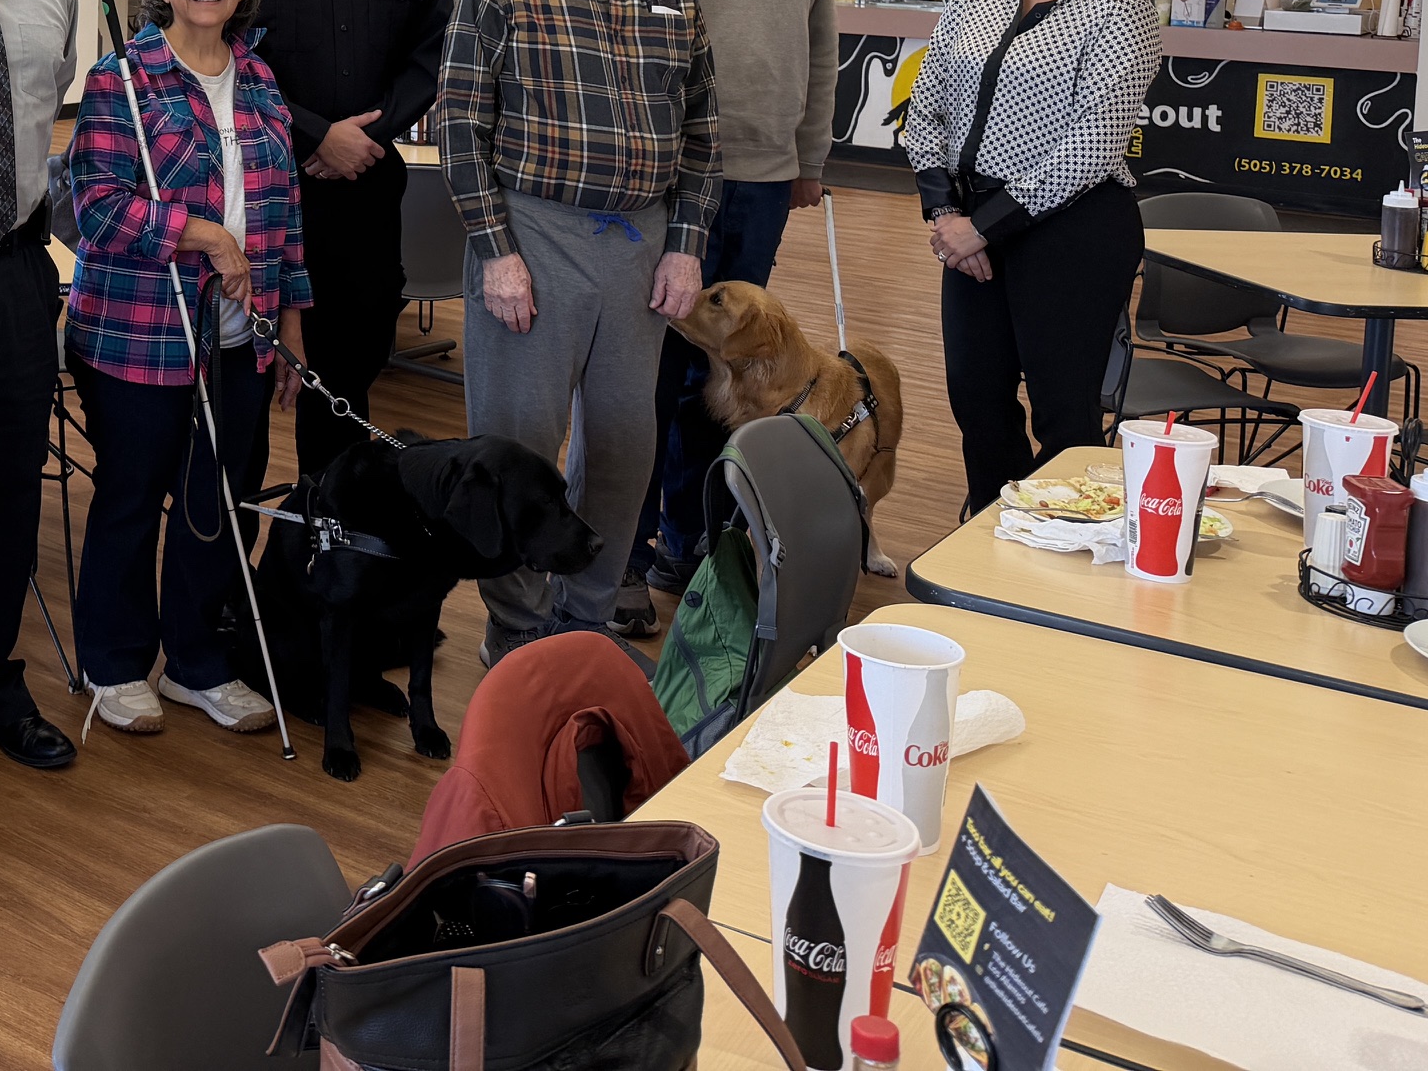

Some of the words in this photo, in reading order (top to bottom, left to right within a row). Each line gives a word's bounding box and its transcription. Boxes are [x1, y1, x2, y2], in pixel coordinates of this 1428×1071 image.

[1136, 104, 1222, 132] eout
[1234, 157, 1276, 175] (505)
[1281, 162, 1362, 181] 378-7034
[1304, 473, 1334, 496] Coke
[1140, 492, 1182, 516] Coca-Cola
[904, 744, 948, 768] Coke
[966, 839, 983, 866] Soup
[987, 869, 1012, 899] Salad
[1009, 892, 1027, 913] Bar
[998, 865, 1020, 887] you
[1017, 883, 1035, 904] can
[784, 927, 846, 972] Coca-Cola
[988, 921, 1023, 959] Follow
[1021, 954, 1036, 974] Us
